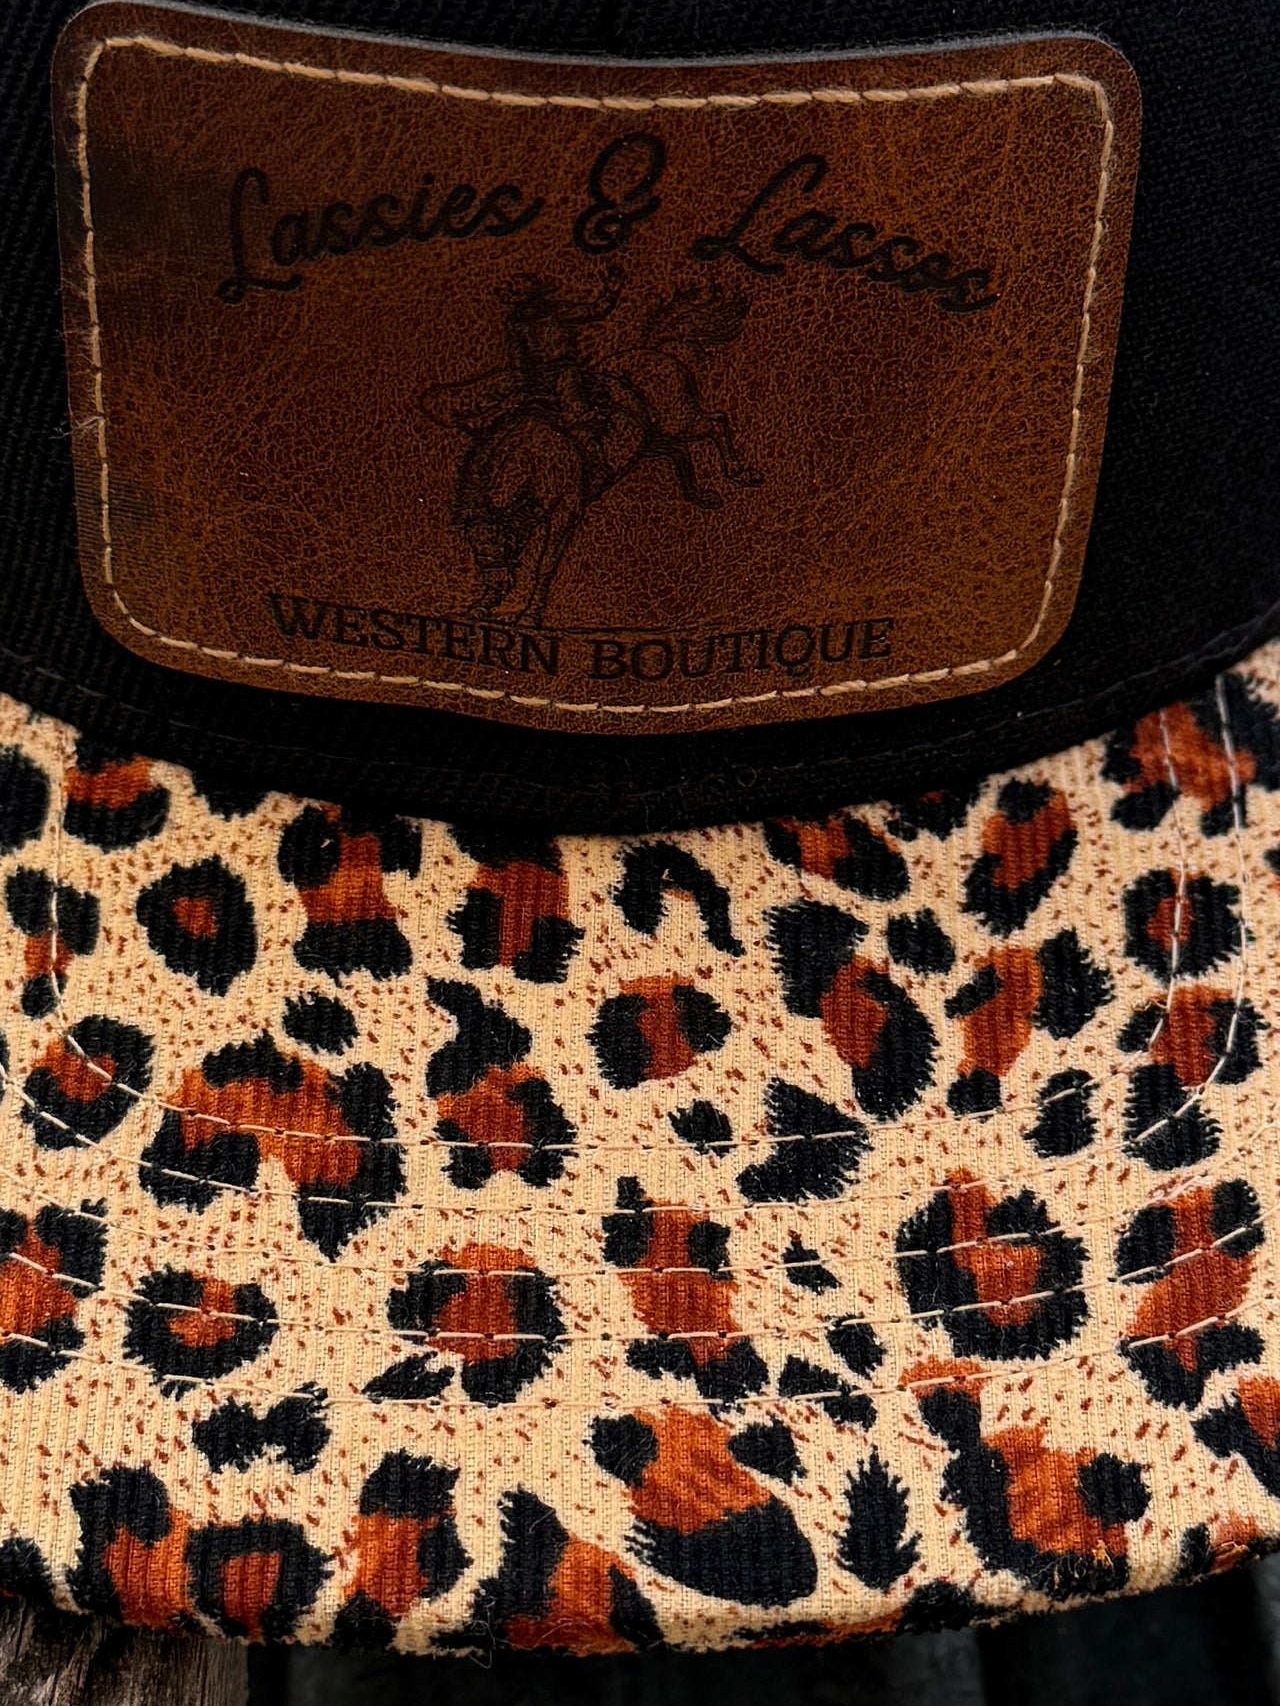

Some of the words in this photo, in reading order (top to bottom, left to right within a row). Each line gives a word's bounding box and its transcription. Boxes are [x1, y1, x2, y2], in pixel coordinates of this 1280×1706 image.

[217, 167, 544, 305] Lassies
[574, 133, 666, 254] &
[269, 594, 560, 677] WESTERN
[589, 618, 894, 680] BOUTIQUE
